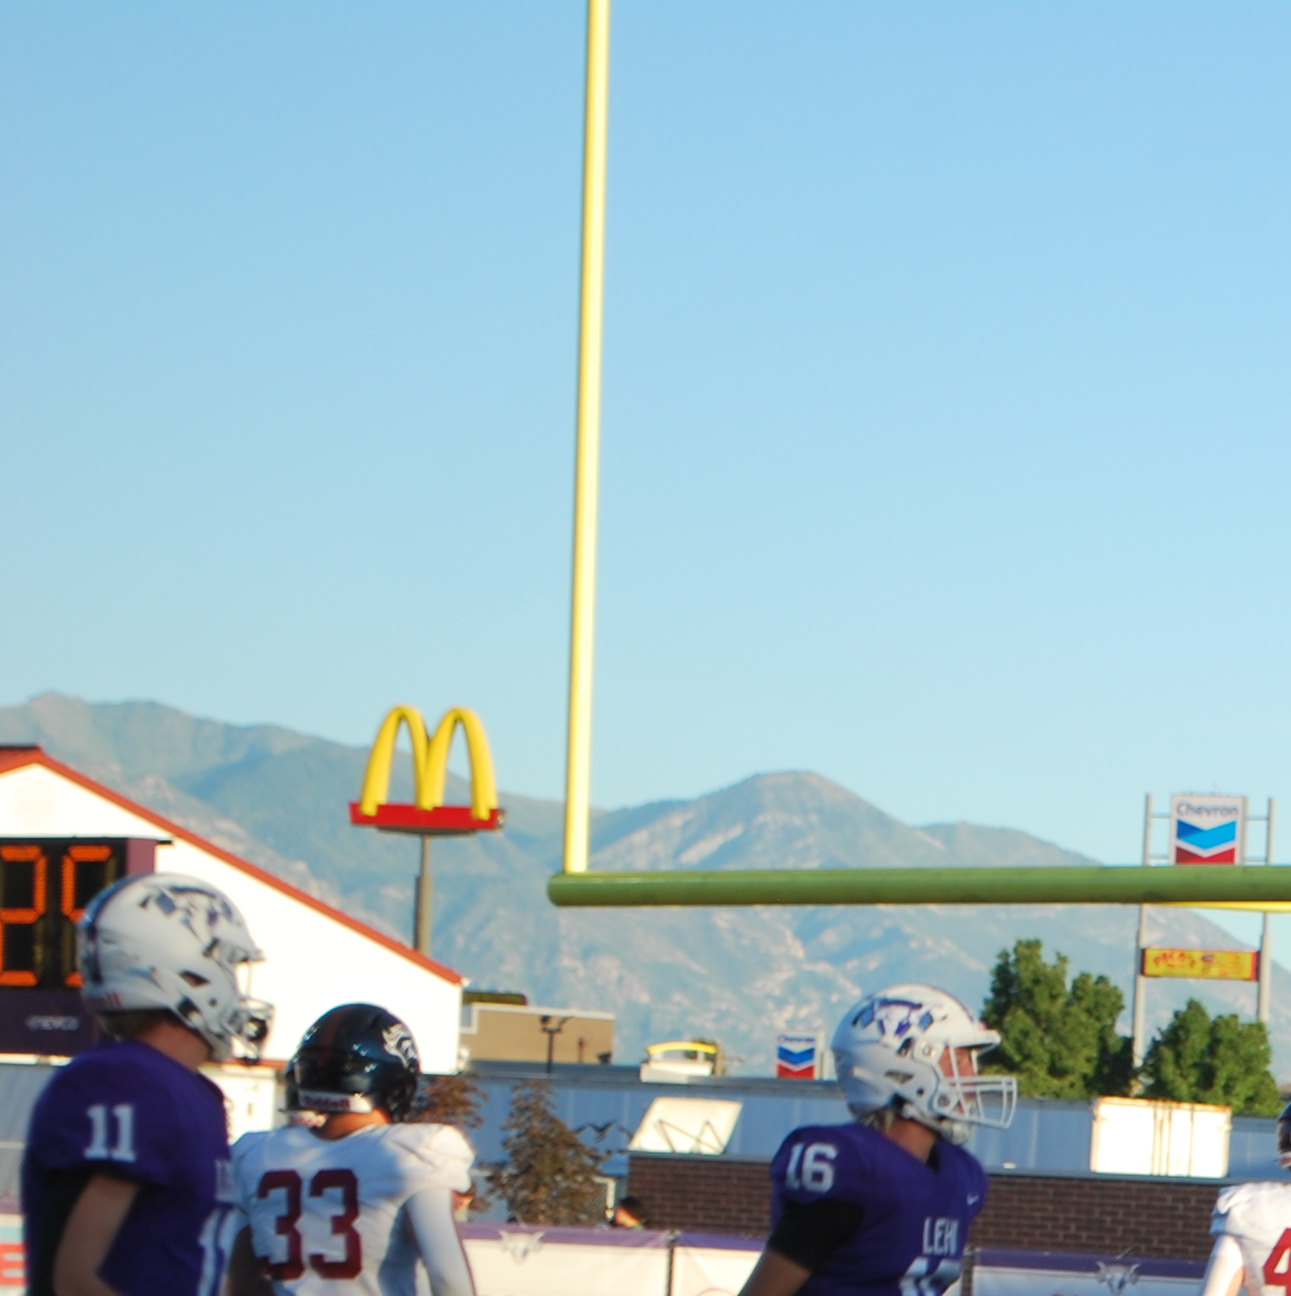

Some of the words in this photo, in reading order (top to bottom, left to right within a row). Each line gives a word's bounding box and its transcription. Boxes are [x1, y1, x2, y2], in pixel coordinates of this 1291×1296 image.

[1177, 803, 1238, 818] Chevron
[84, 1104, 136, 1162] 11
[785, 1143, 837, 1193] 16
[258, 1169, 363, 1281] 33
[922, 1217, 959, 1256] LEH
